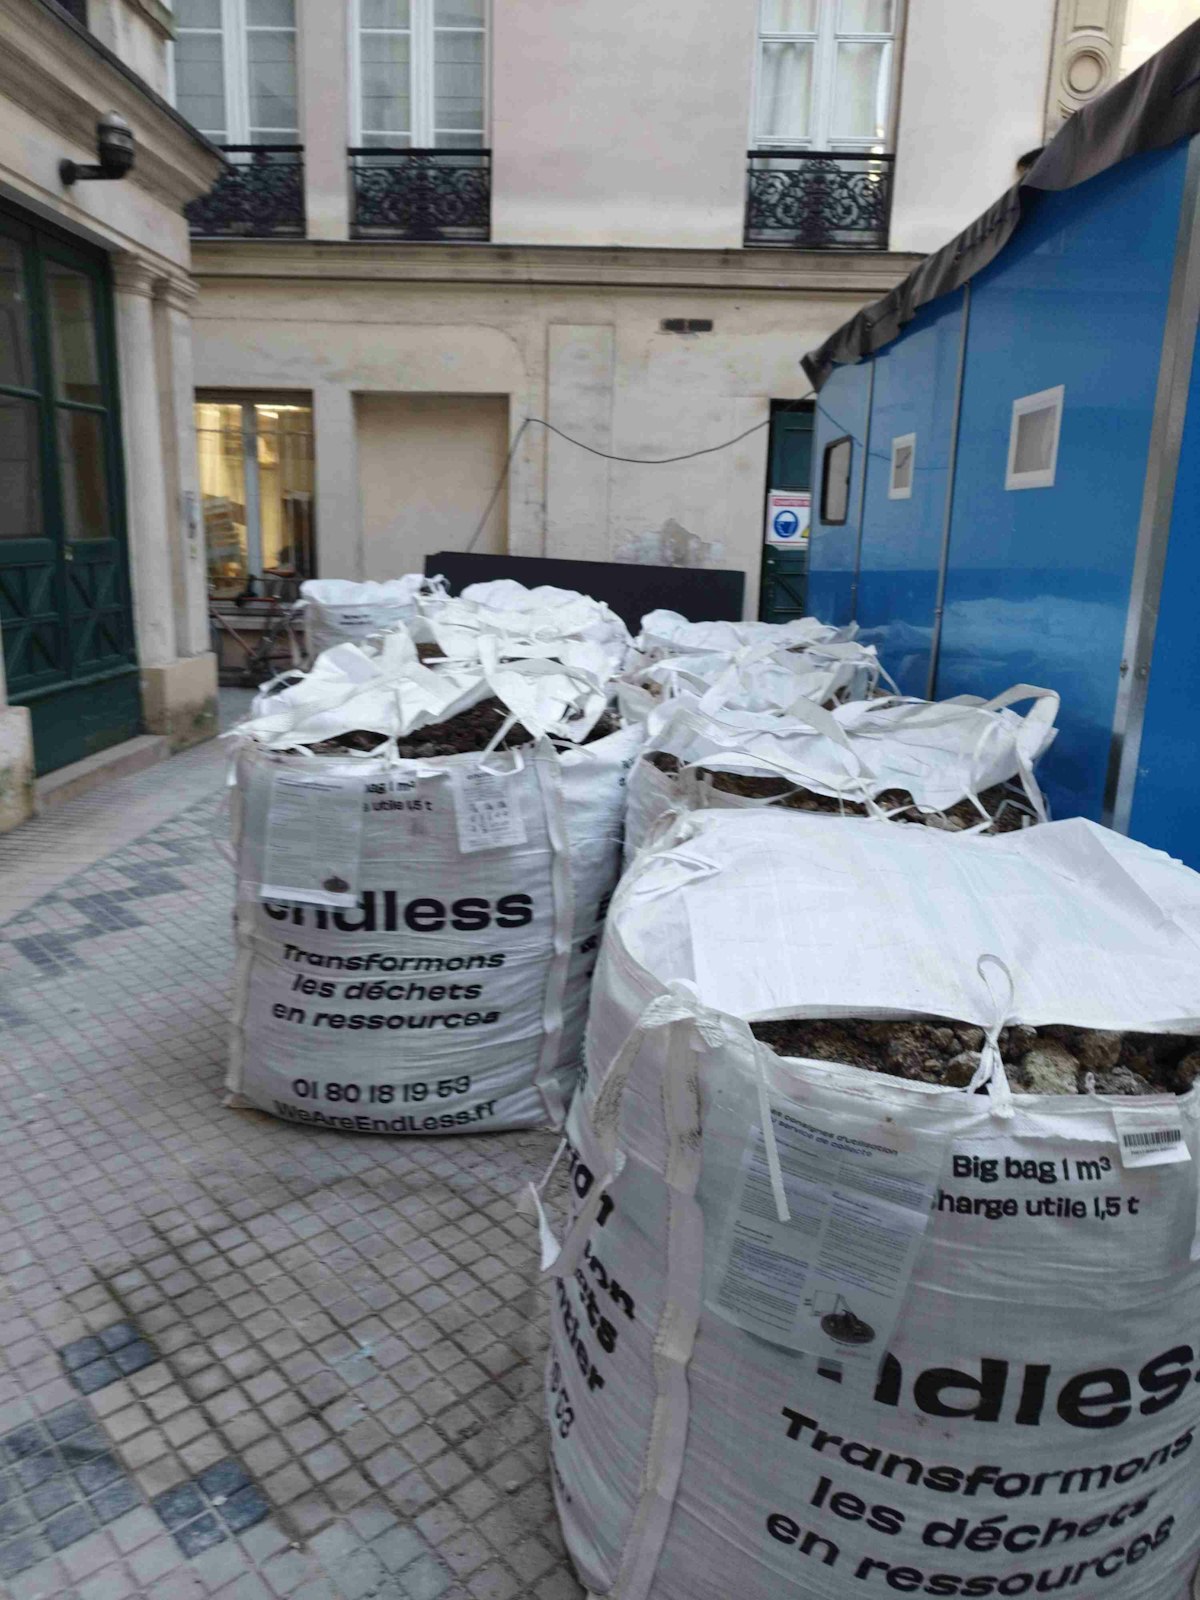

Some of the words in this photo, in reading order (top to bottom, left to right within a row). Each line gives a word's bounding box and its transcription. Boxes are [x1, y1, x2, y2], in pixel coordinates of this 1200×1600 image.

[283, 943, 506, 972] Transformons
[292, 974, 337, 999] les
[343, 979, 483, 1002] déchets
[272, 1003, 306, 1024] en
[313, 1009, 502, 1031] ressources
[291, 1078, 319, 1100] 01
[326, 1081, 362, 1104] 80
[369, 1084, 396, 1104] 18
[402, 1081, 430, 1103] 19
[952, 1154, 999, 1183] Big
[1004, 1156, 1058, 1185] bag
[1025, 1196, 1087, 1219] utile
[1093, 1196, 1122, 1221] 1,5
[1127, 1195, 1141, 1215] t
[781, 1405, 1197, 1500] Transformons
[809, 1476, 907, 1536] les
[765, 1512, 841, 1568] en
[854, 1514, 1176, 1598] ressources
